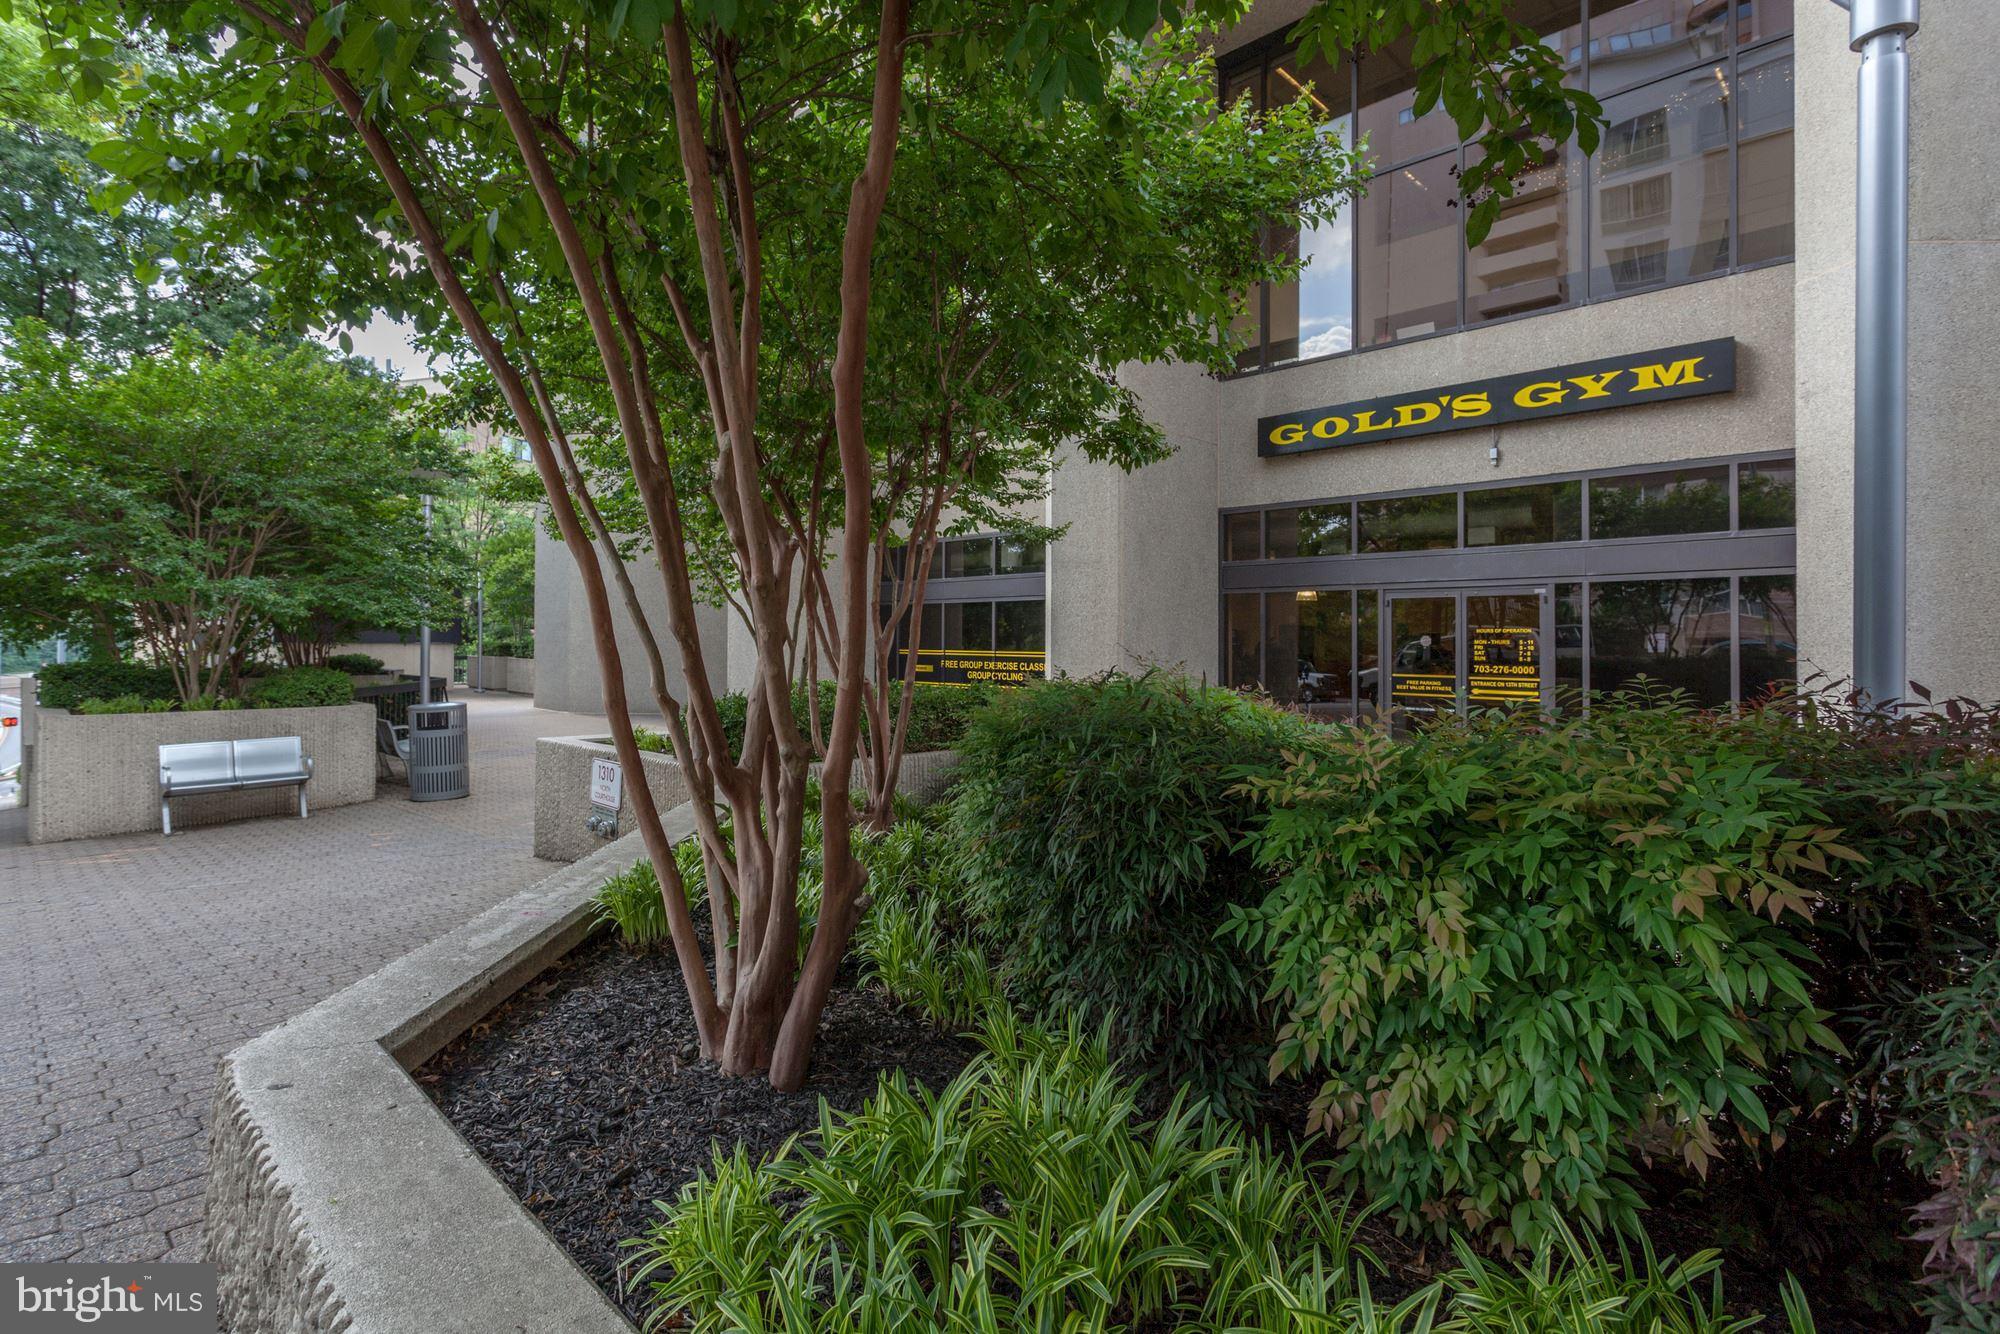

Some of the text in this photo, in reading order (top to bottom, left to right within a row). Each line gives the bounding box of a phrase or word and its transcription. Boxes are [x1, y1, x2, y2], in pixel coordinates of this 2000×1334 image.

[1269, 356, 1705, 446] GOLD'S GYM
[941, 660, 958, 669] FREE
[960, 660, 983, 670] GROUP
[984, 661, 1018, 670] EXERCISE
[1474, 665, 1534, 674] 703-276-0000
[967, 670, 1024, 681] GROUP CYCLING
[598, 764, 614, 782] 1310
